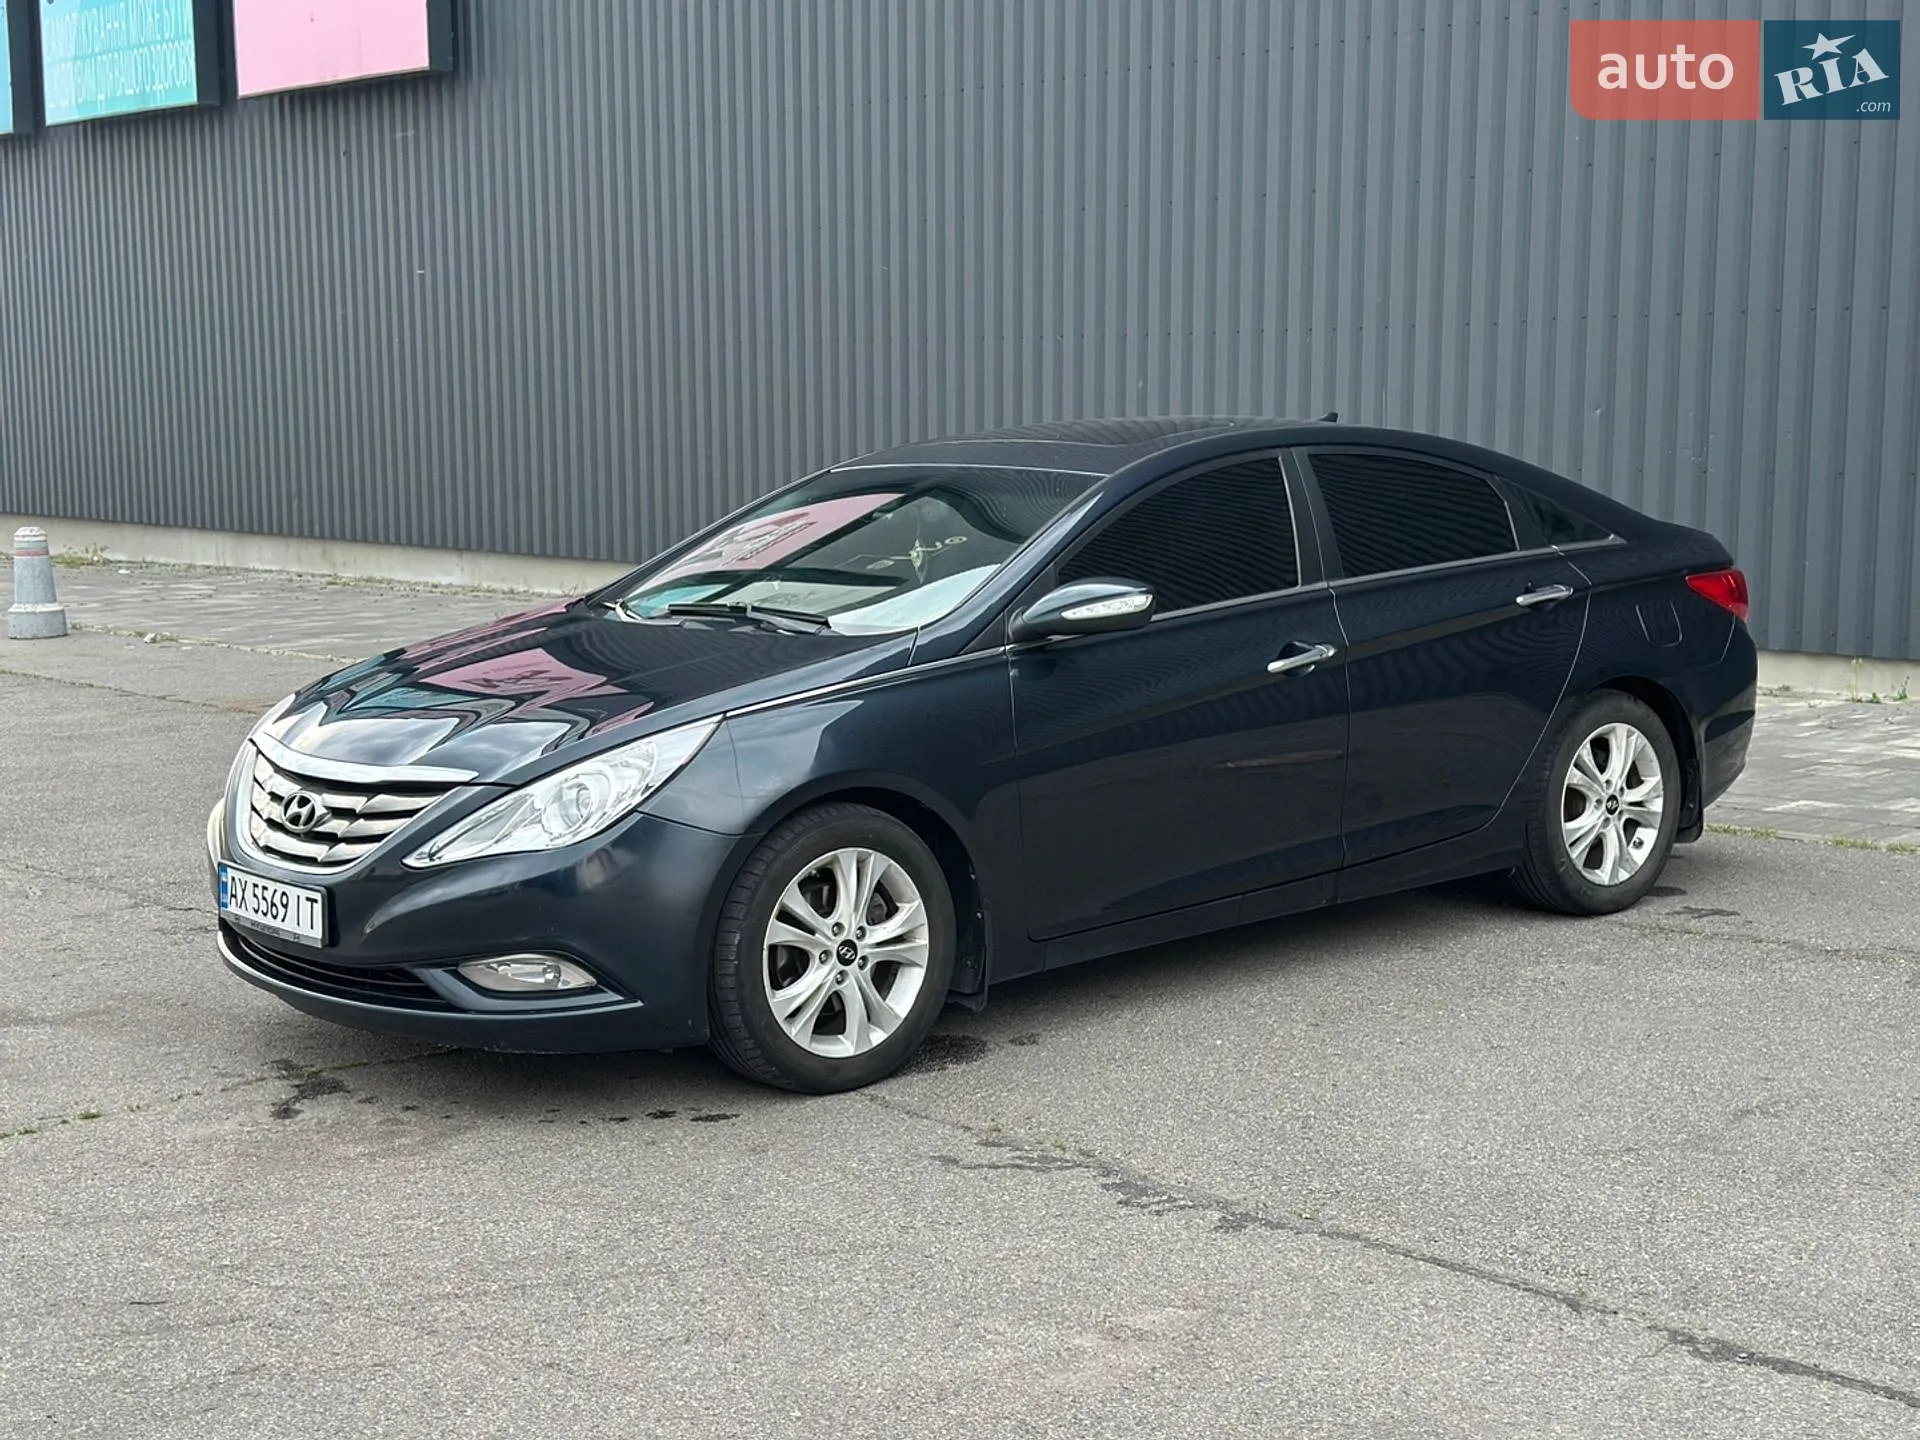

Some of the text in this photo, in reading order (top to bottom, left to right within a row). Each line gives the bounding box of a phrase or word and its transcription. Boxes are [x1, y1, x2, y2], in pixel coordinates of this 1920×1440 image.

[229, 876, 248, 912] AX
[252, 882, 289, 923] 5569
[296, 894, 318, 930] IT
